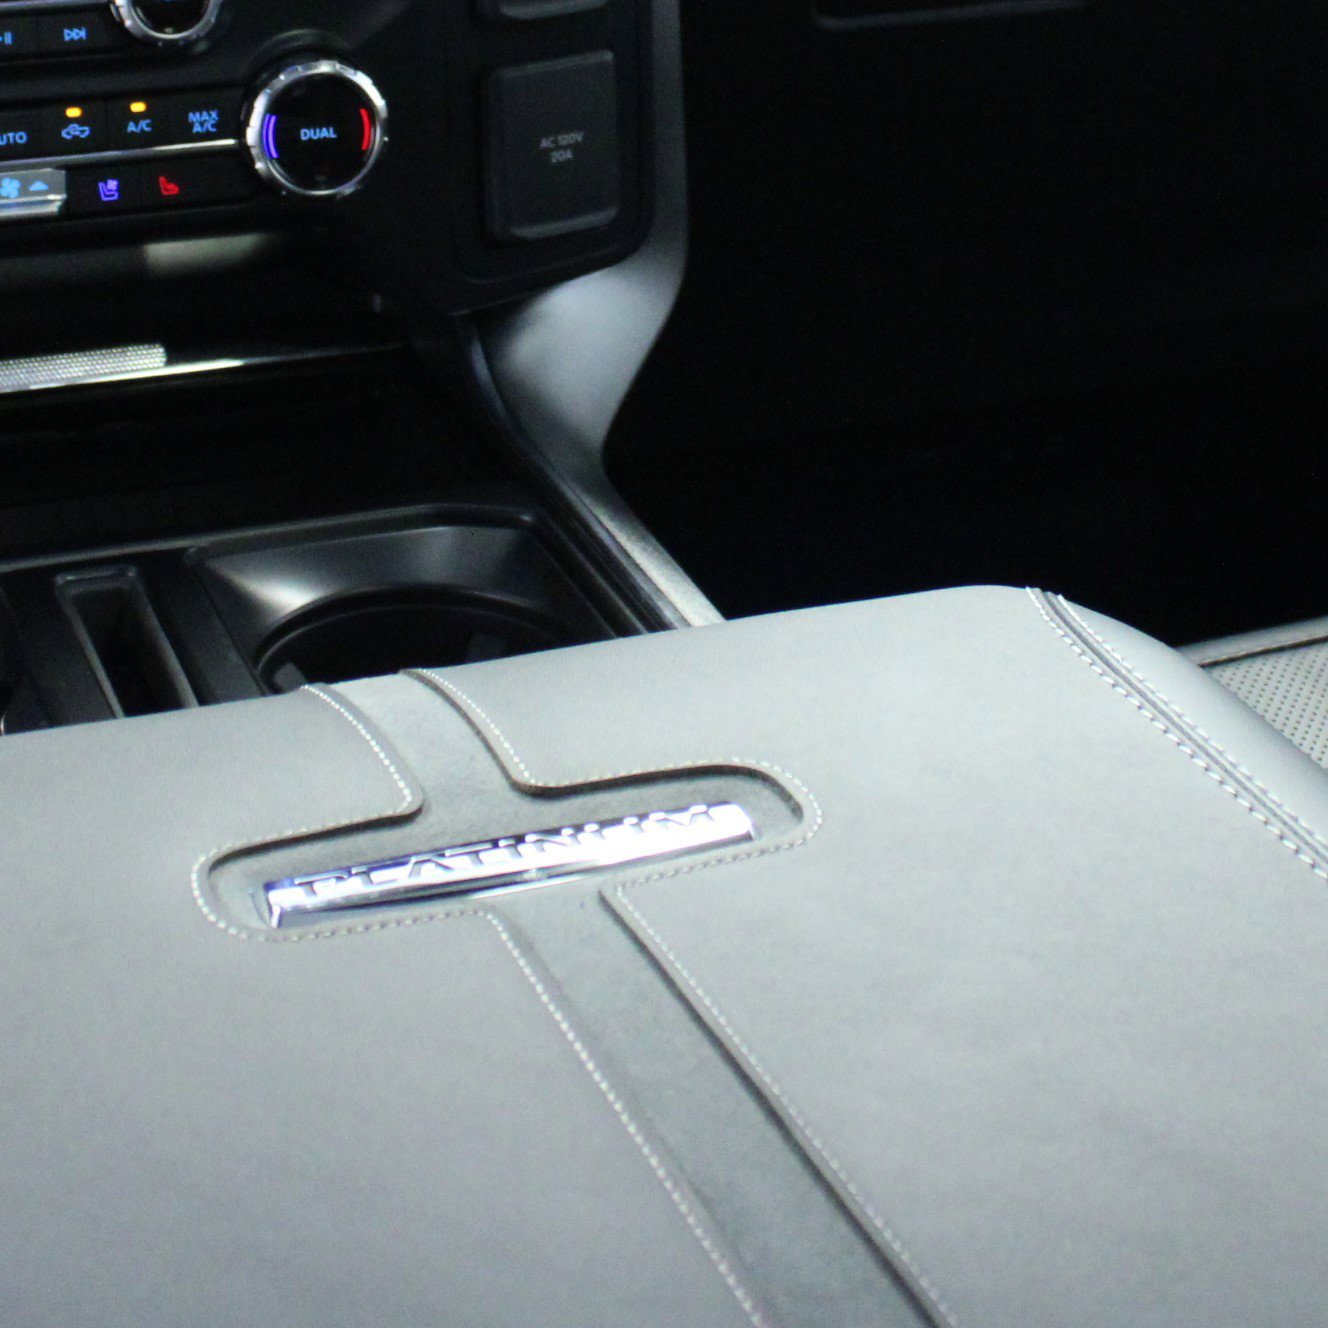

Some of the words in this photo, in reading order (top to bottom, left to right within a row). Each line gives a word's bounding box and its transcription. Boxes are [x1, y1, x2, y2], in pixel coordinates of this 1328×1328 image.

[188, 109, 218, 122] MAX
[127, 119, 152, 133] A/C
[192, 120, 217, 133] A/C
[299, 126, 338, 141] DUAL
